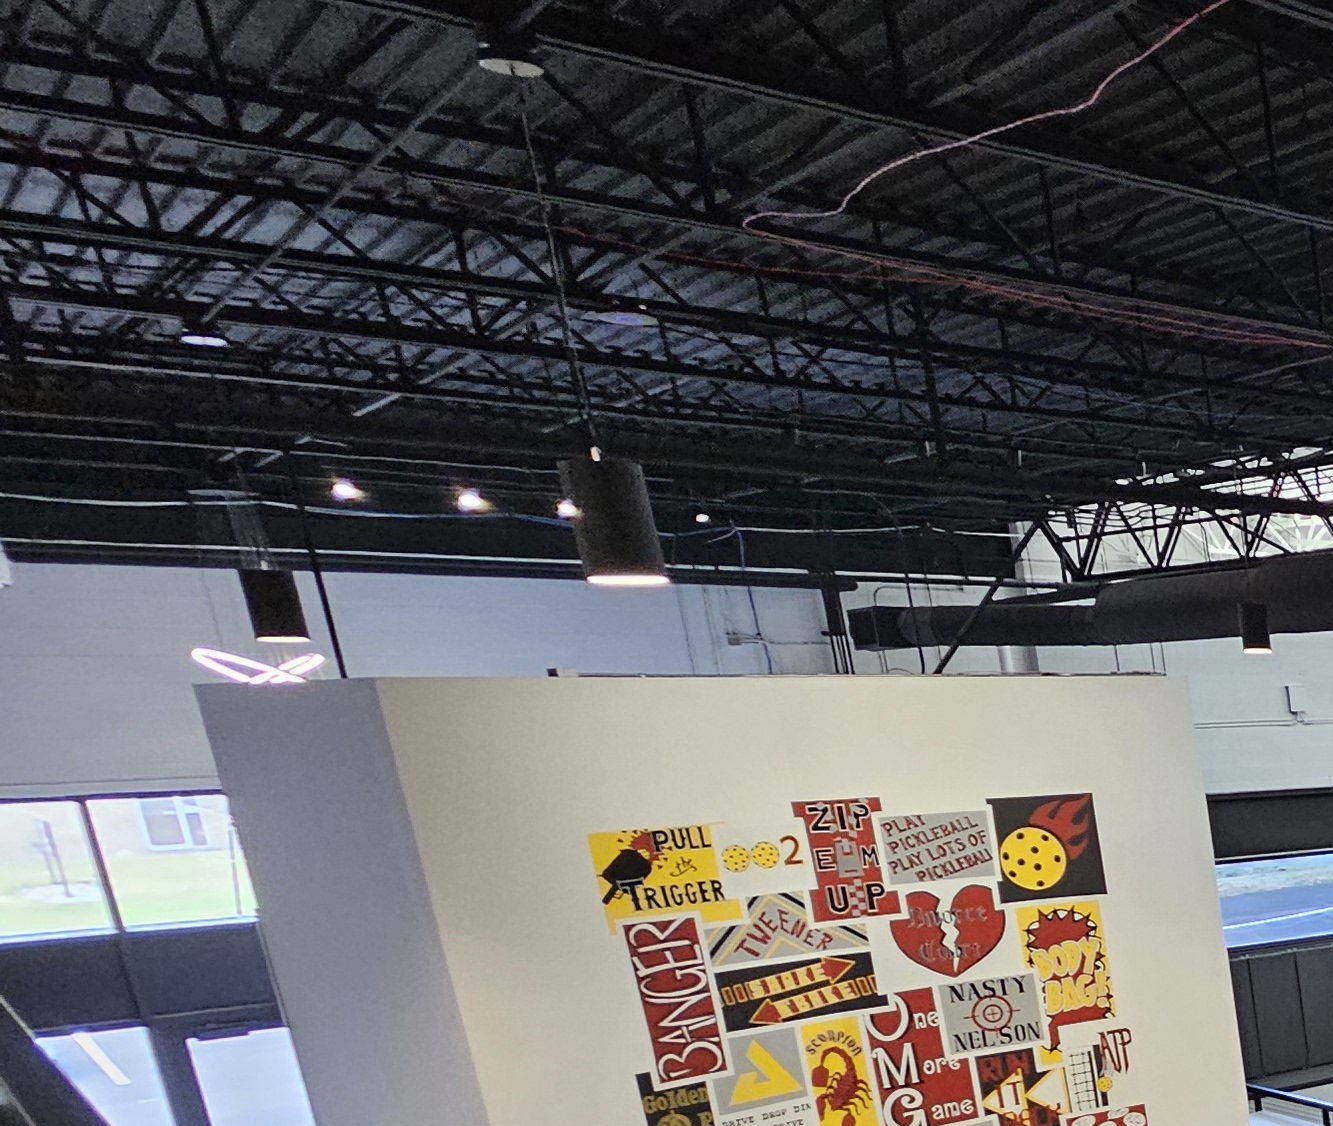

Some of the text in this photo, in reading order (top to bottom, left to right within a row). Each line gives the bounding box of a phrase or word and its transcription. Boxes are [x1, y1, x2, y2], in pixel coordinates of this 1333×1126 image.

[806, 801, 871, 834] ZIP
[880, 814, 926, 837] PLAY
[651, 825, 712, 852] PULL
[886, 816, 978, 855] PICKLEBALL
[887, 830, 987, 874] PLAY LOTS OF
[618, 877, 726, 912] TRIGGER
[827, 881, 886, 915] UP
[734, 907, 834, 959] TWEENER
[1031, 936, 1101, 981] BODY
[628, 917, 723, 1080] BANGER
[948, 975, 1026, 1004] NASTY
[953, 1021, 1041, 1052] NELSON
[643, 1087, 709, 1114] Golden
[762, 1108, 788, 1120] DROP
